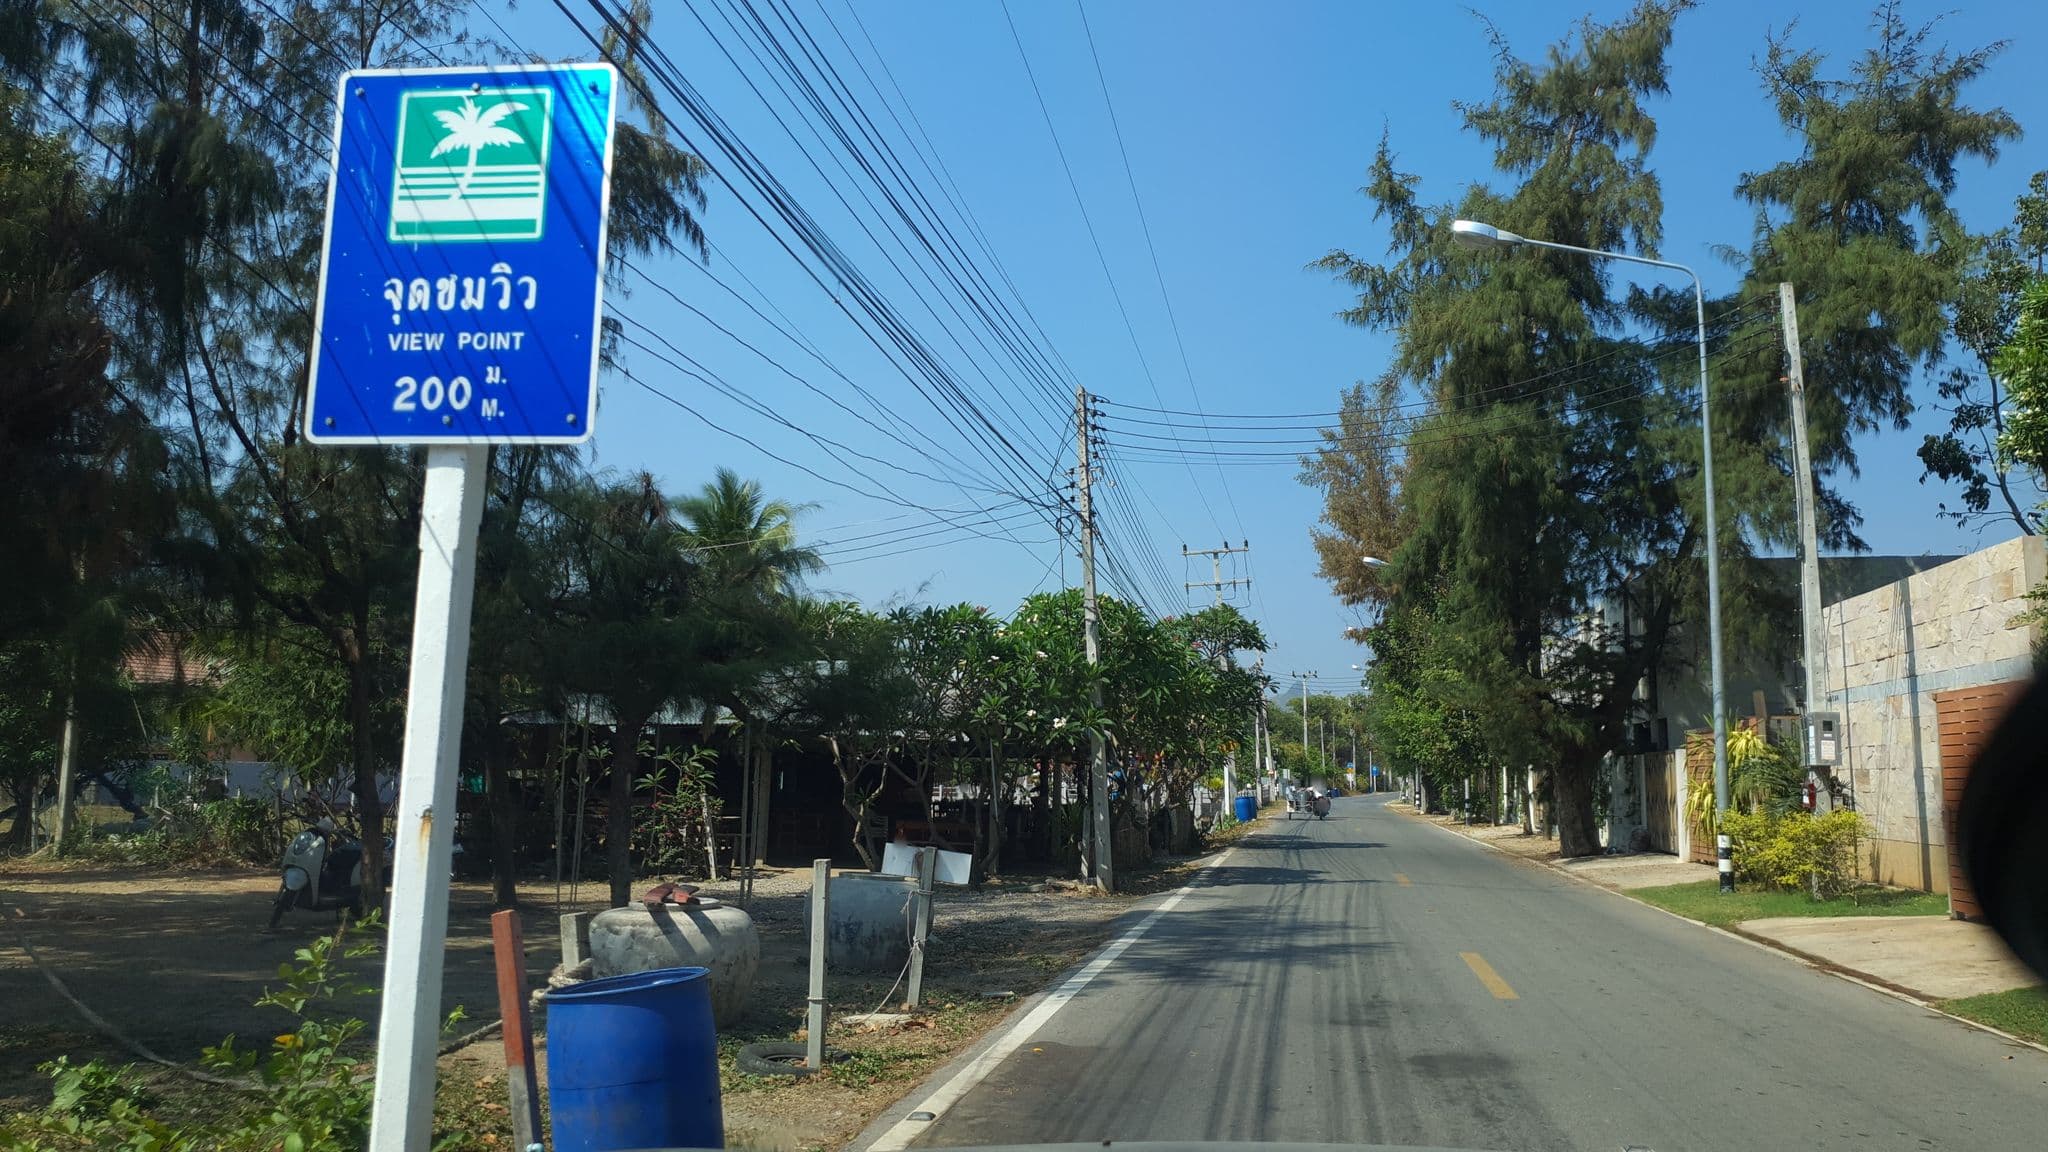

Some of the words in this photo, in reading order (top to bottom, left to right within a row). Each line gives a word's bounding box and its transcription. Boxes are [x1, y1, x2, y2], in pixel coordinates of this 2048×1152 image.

[384, 263, 537, 325] จุดชมวิว
[389, 332, 445, 351] VIEW
[458, 332, 524, 351] POINT
[393, 376, 472, 412] 200
[485, 366, 507, 384] ม.
[481, 399, 505, 418] M.
